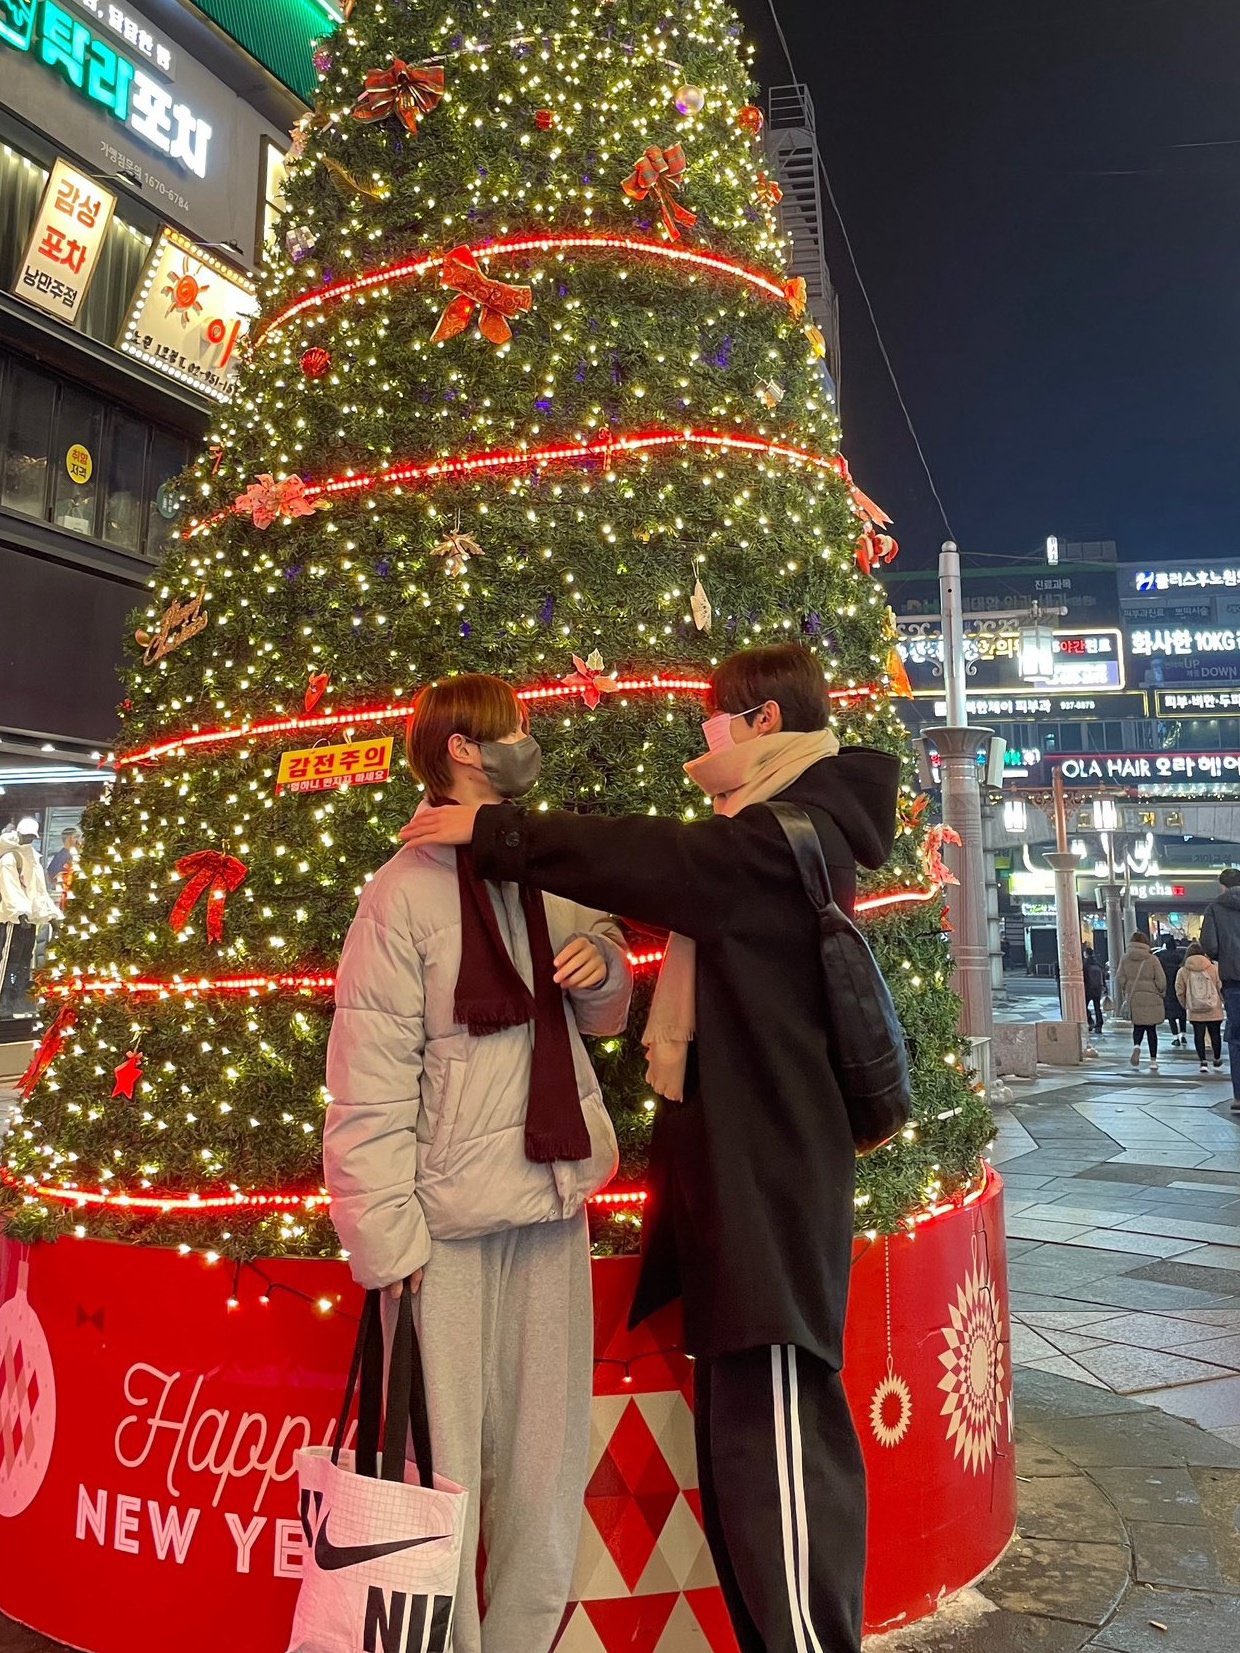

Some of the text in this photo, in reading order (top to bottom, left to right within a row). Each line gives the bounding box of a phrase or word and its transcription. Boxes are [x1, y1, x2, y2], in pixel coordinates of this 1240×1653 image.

[54, 178, 102, 229] 감성
[144, 172, 190, 212] 1670-6784
[37, 225, 87, 275] 포차
[23, 265, 78, 308] 낭만주점
[1131, 629, 1193, 656] 화사한
[1201, 666, 1237, 678] DOWN
[288, 746, 386, 779] 감전주의
[1062, 759, 1102, 778] OLA
[1107, 758, 1151, 777] HAIR
[286, 779, 320, 792] 험하니
[355, 770, 384, 783] 마세요
[1148, 881, 1173, 896] cha
[76, 1483, 201, 1564] NEW
[224, 1512, 304, 1579] YE
